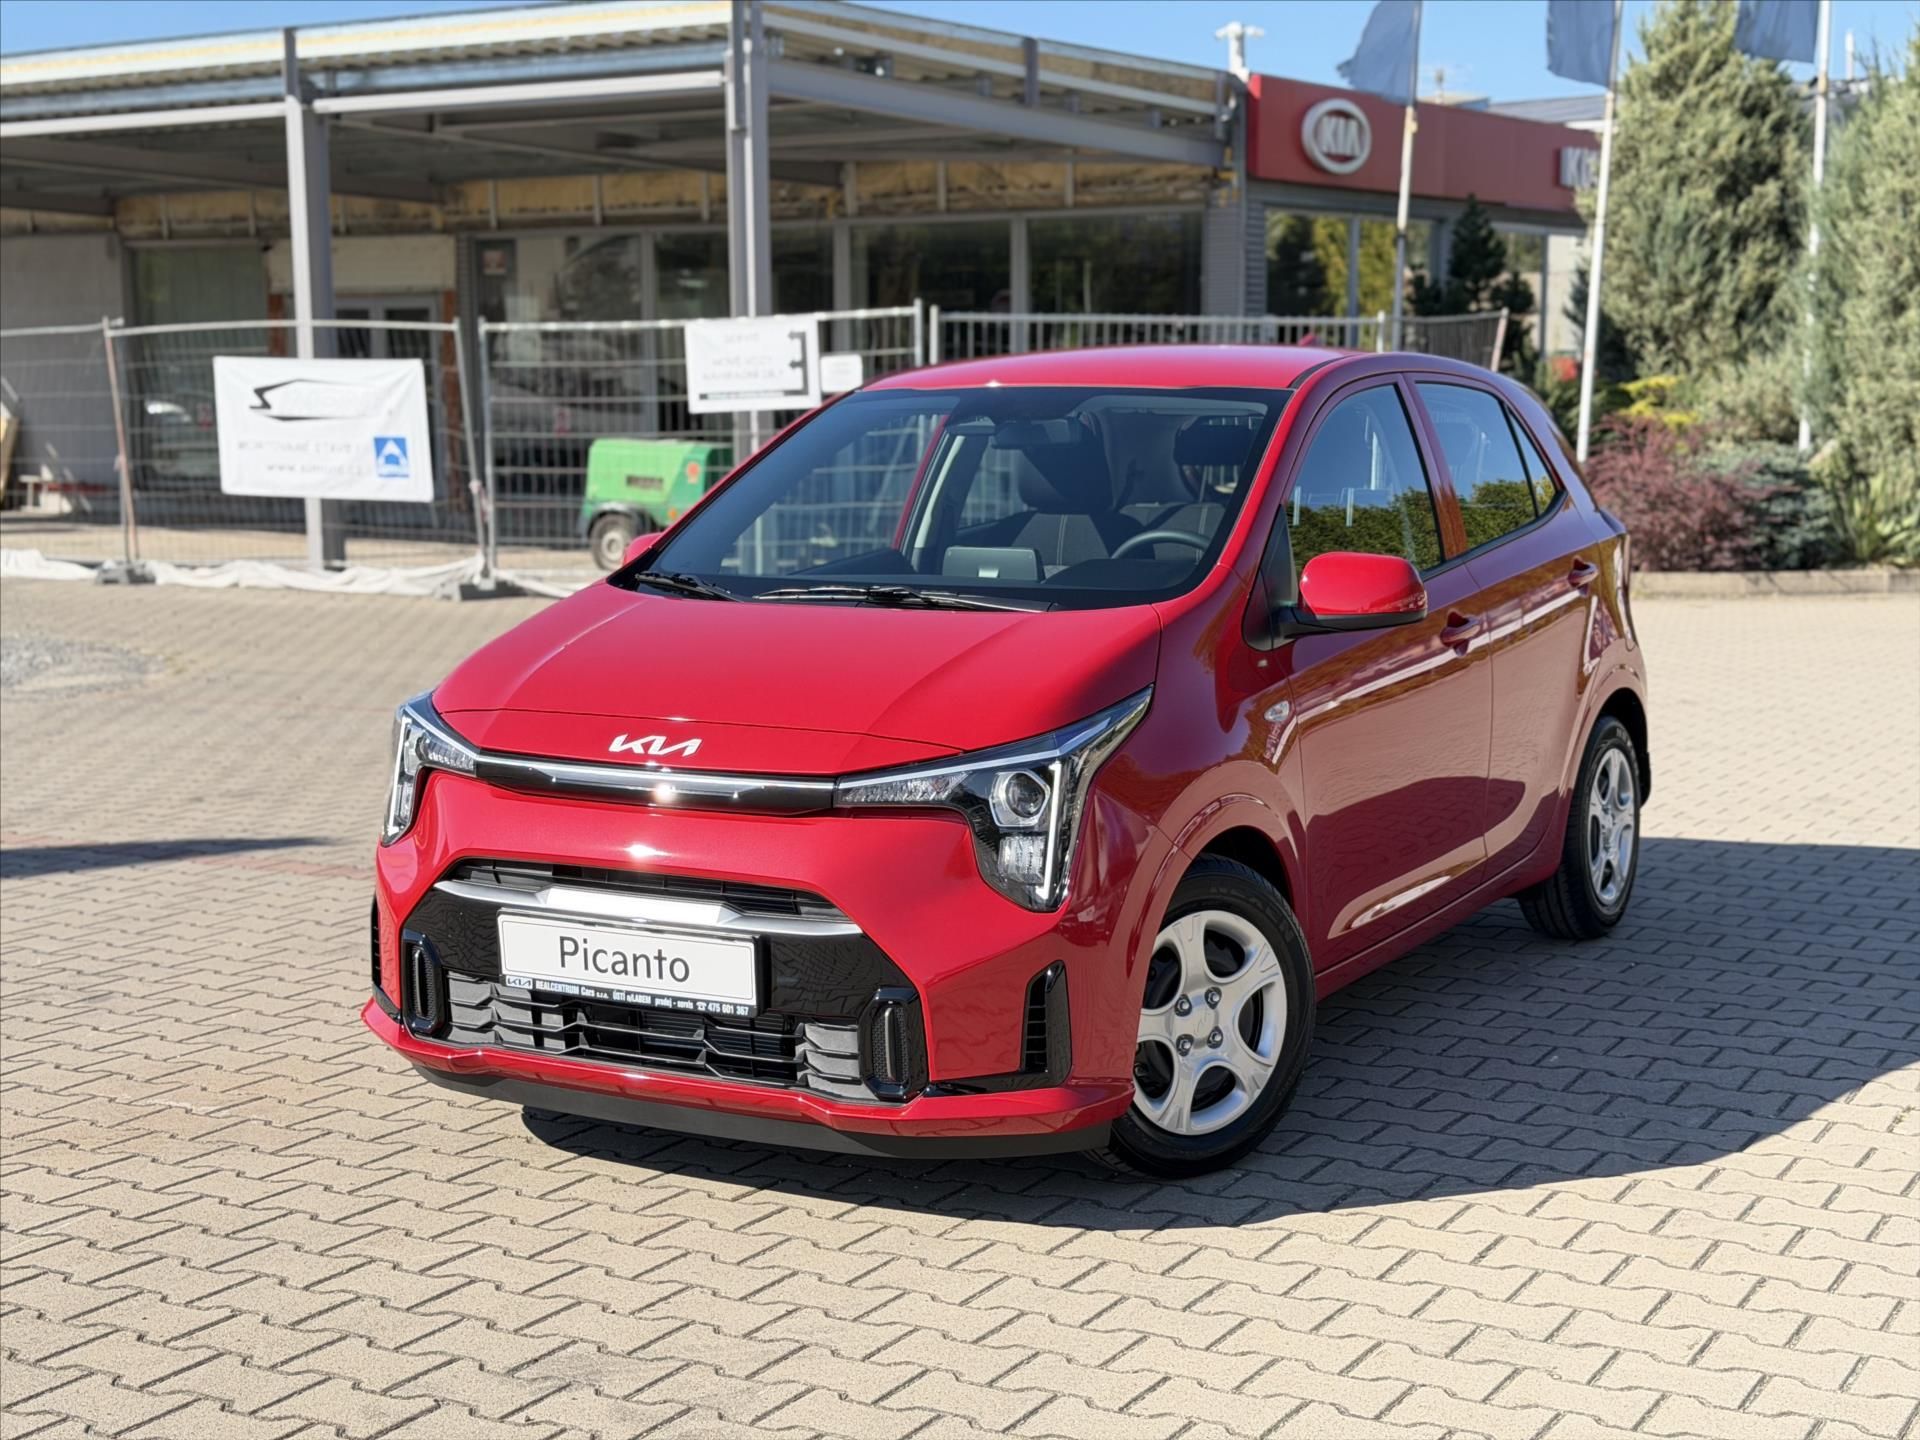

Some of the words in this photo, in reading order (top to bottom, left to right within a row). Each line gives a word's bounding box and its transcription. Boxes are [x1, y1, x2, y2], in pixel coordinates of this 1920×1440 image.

[1320, 116, 1361, 158] KIA
[608, 733, 702, 757] KIA
[559, 935, 690, 983] Picanto
[535, 979, 580, 995] REALCENTRUM
[581, 986, 595, 997] Cars
[708, 1002, 721, 1012] 475
[722, 1004, 735, 1015] 601
